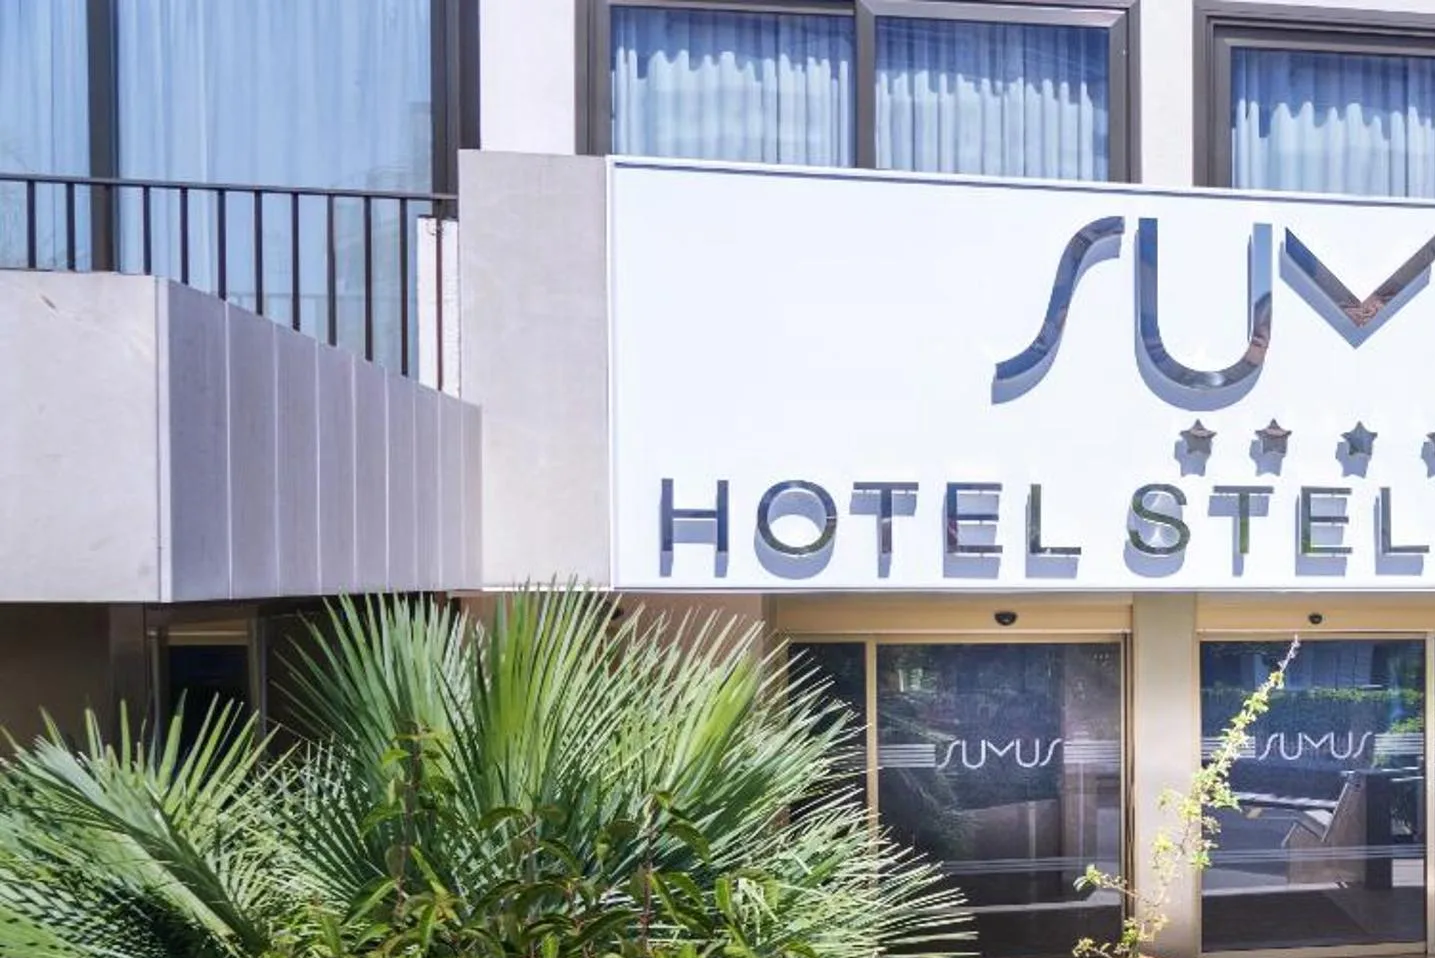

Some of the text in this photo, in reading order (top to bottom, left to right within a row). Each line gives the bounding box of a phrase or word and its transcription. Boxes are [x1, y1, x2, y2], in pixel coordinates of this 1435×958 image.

[659, 478, 1082, 556] HOTEL
[936, 737, 1063, 769] SUMUS
[1258, 731, 1373, 761] SUMUS
